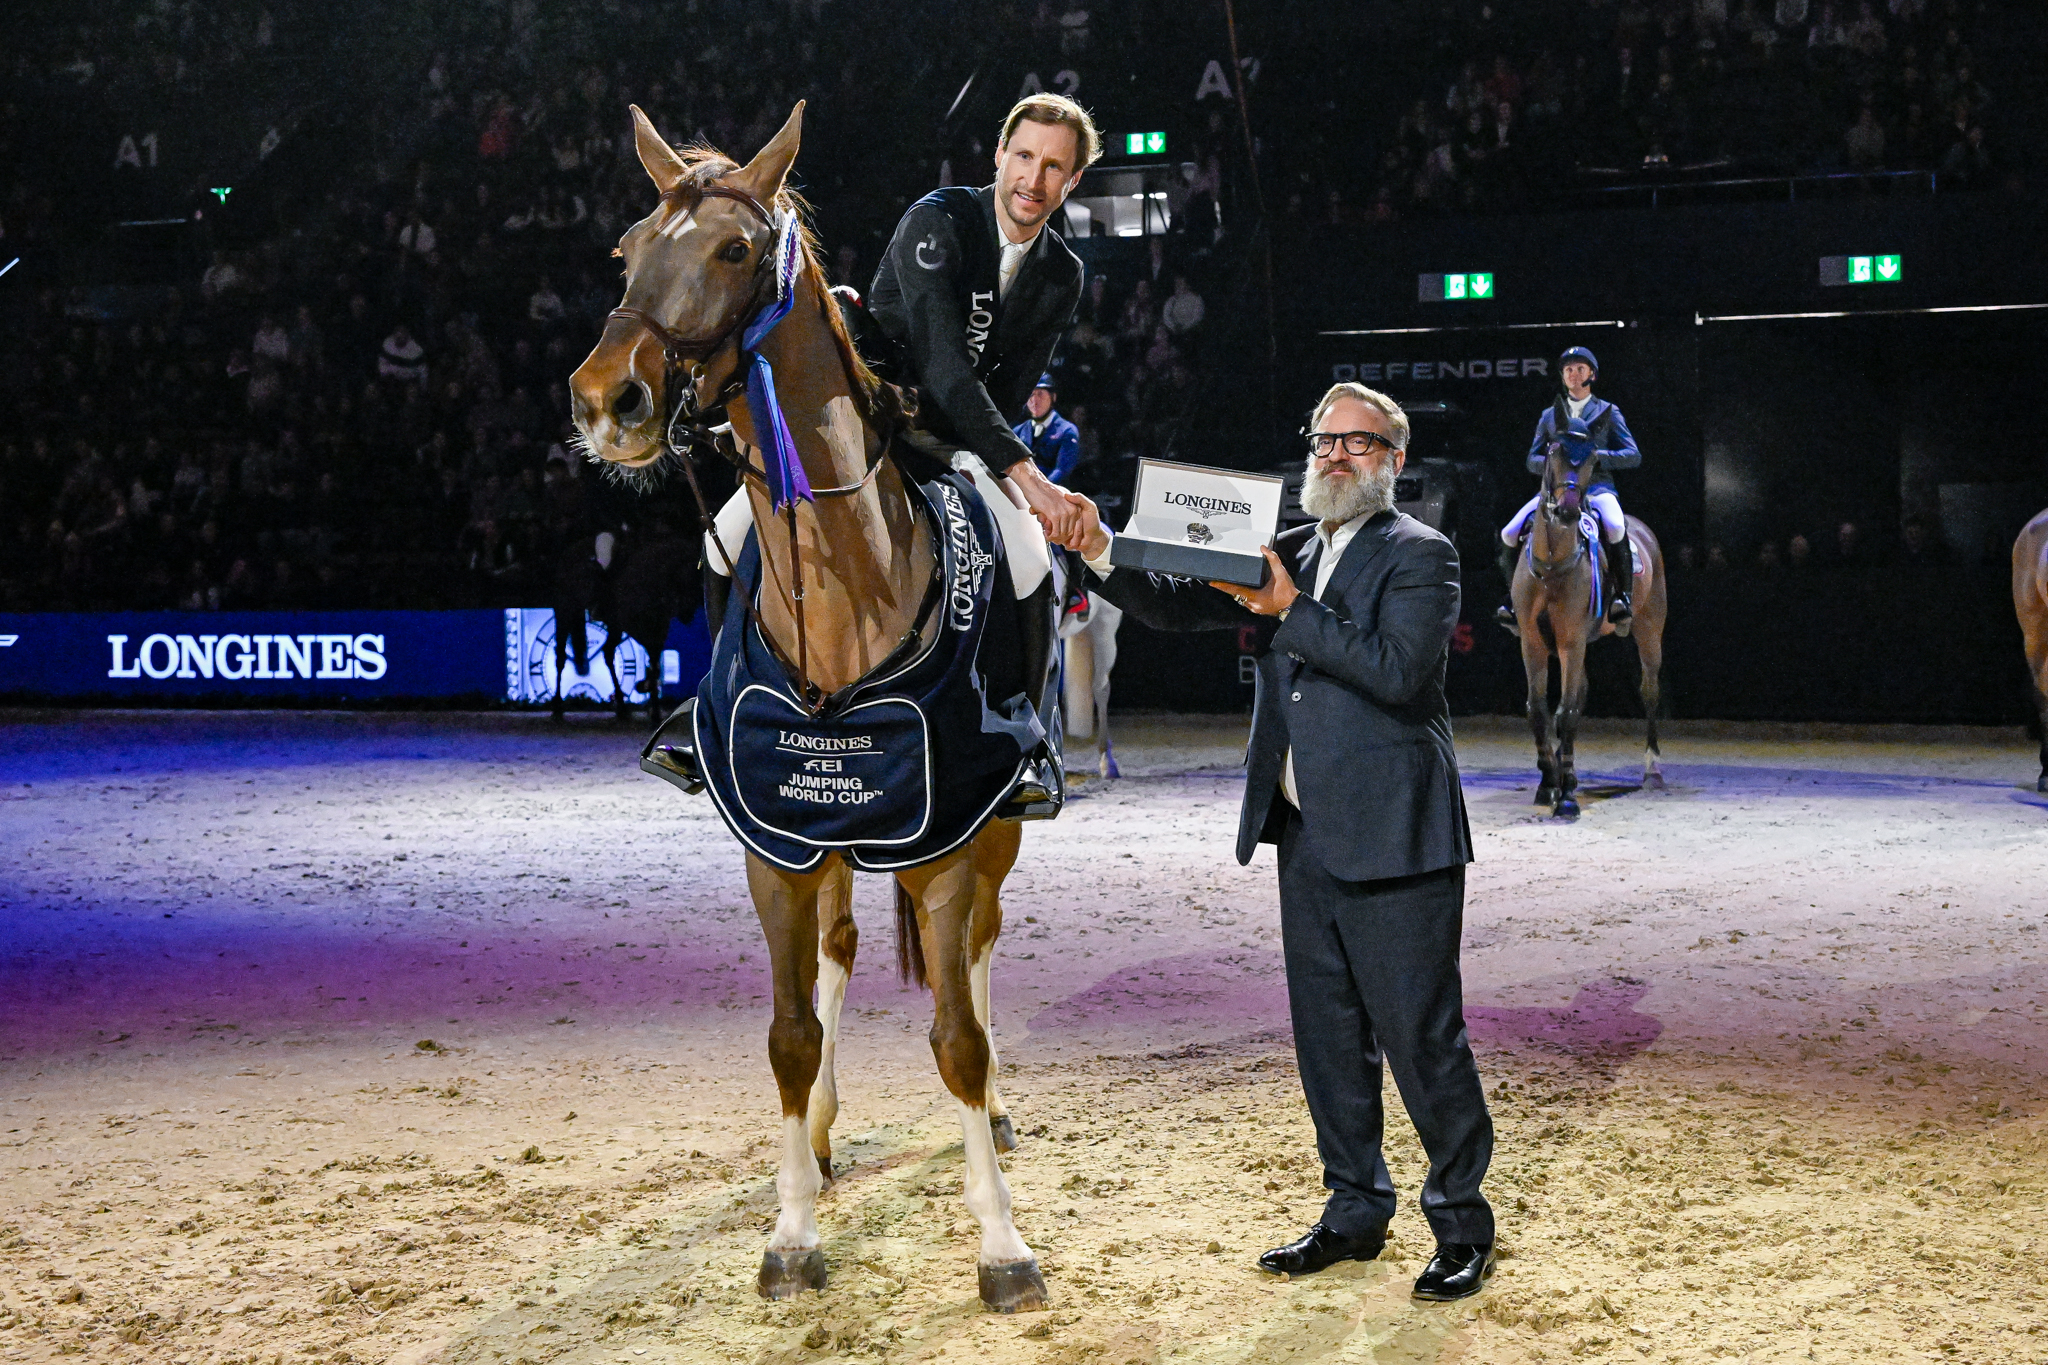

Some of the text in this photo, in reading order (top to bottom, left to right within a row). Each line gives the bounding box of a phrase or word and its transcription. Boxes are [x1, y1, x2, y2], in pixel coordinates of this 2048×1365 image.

[114, 132, 158, 169] A1
[1331, 357, 1548, 381] DEFENDER
[1164, 491, 1252, 515] LONGINES
[937, 482, 974, 632] LONGINES
[107, 633, 388, 680] LONGINES
[779, 730, 873, 751] LONGINES
[803, 759, 842, 772] FEI
[788, 773, 863, 790] JUMPING
[779, 785, 834, 804] WORLD
